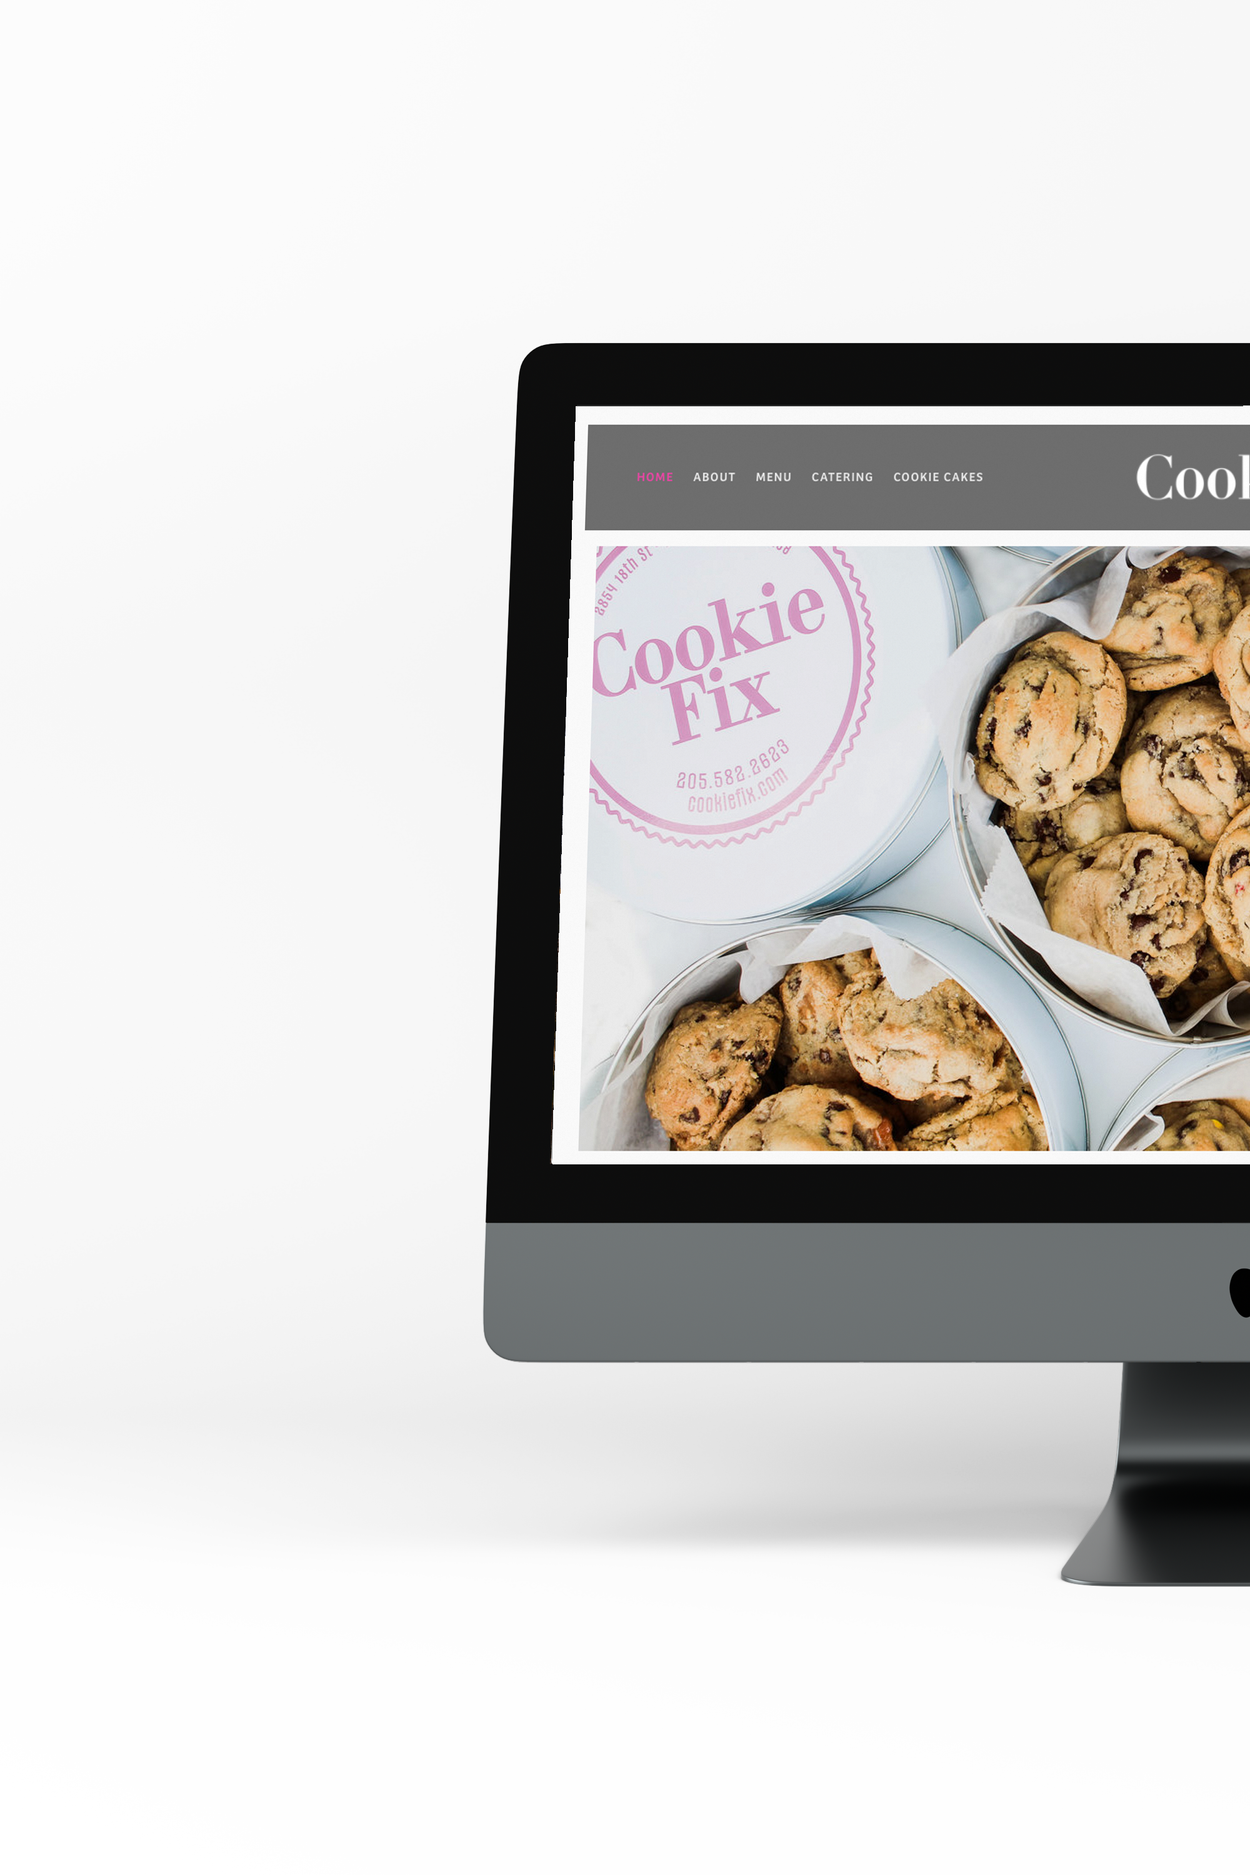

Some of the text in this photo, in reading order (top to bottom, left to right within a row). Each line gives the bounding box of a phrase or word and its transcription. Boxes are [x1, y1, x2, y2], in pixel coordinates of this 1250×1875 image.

[636, 471, 674, 482] HOME
[692, 471, 736, 482] ABOUT
[755, 471, 792, 482] MENU
[811, 471, 873, 482] CATERING
[893, 471, 984, 482] COOKIE CAKES
[594, 583, 618, 617] 2854
[614, 558, 639, 584] 18th
[592, 582, 826, 698] Cookie
[660, 667, 781, 746] Fix
[676, 738, 790, 790] 205.582.2623
[687, 767, 789, 814] cookiefix.com
